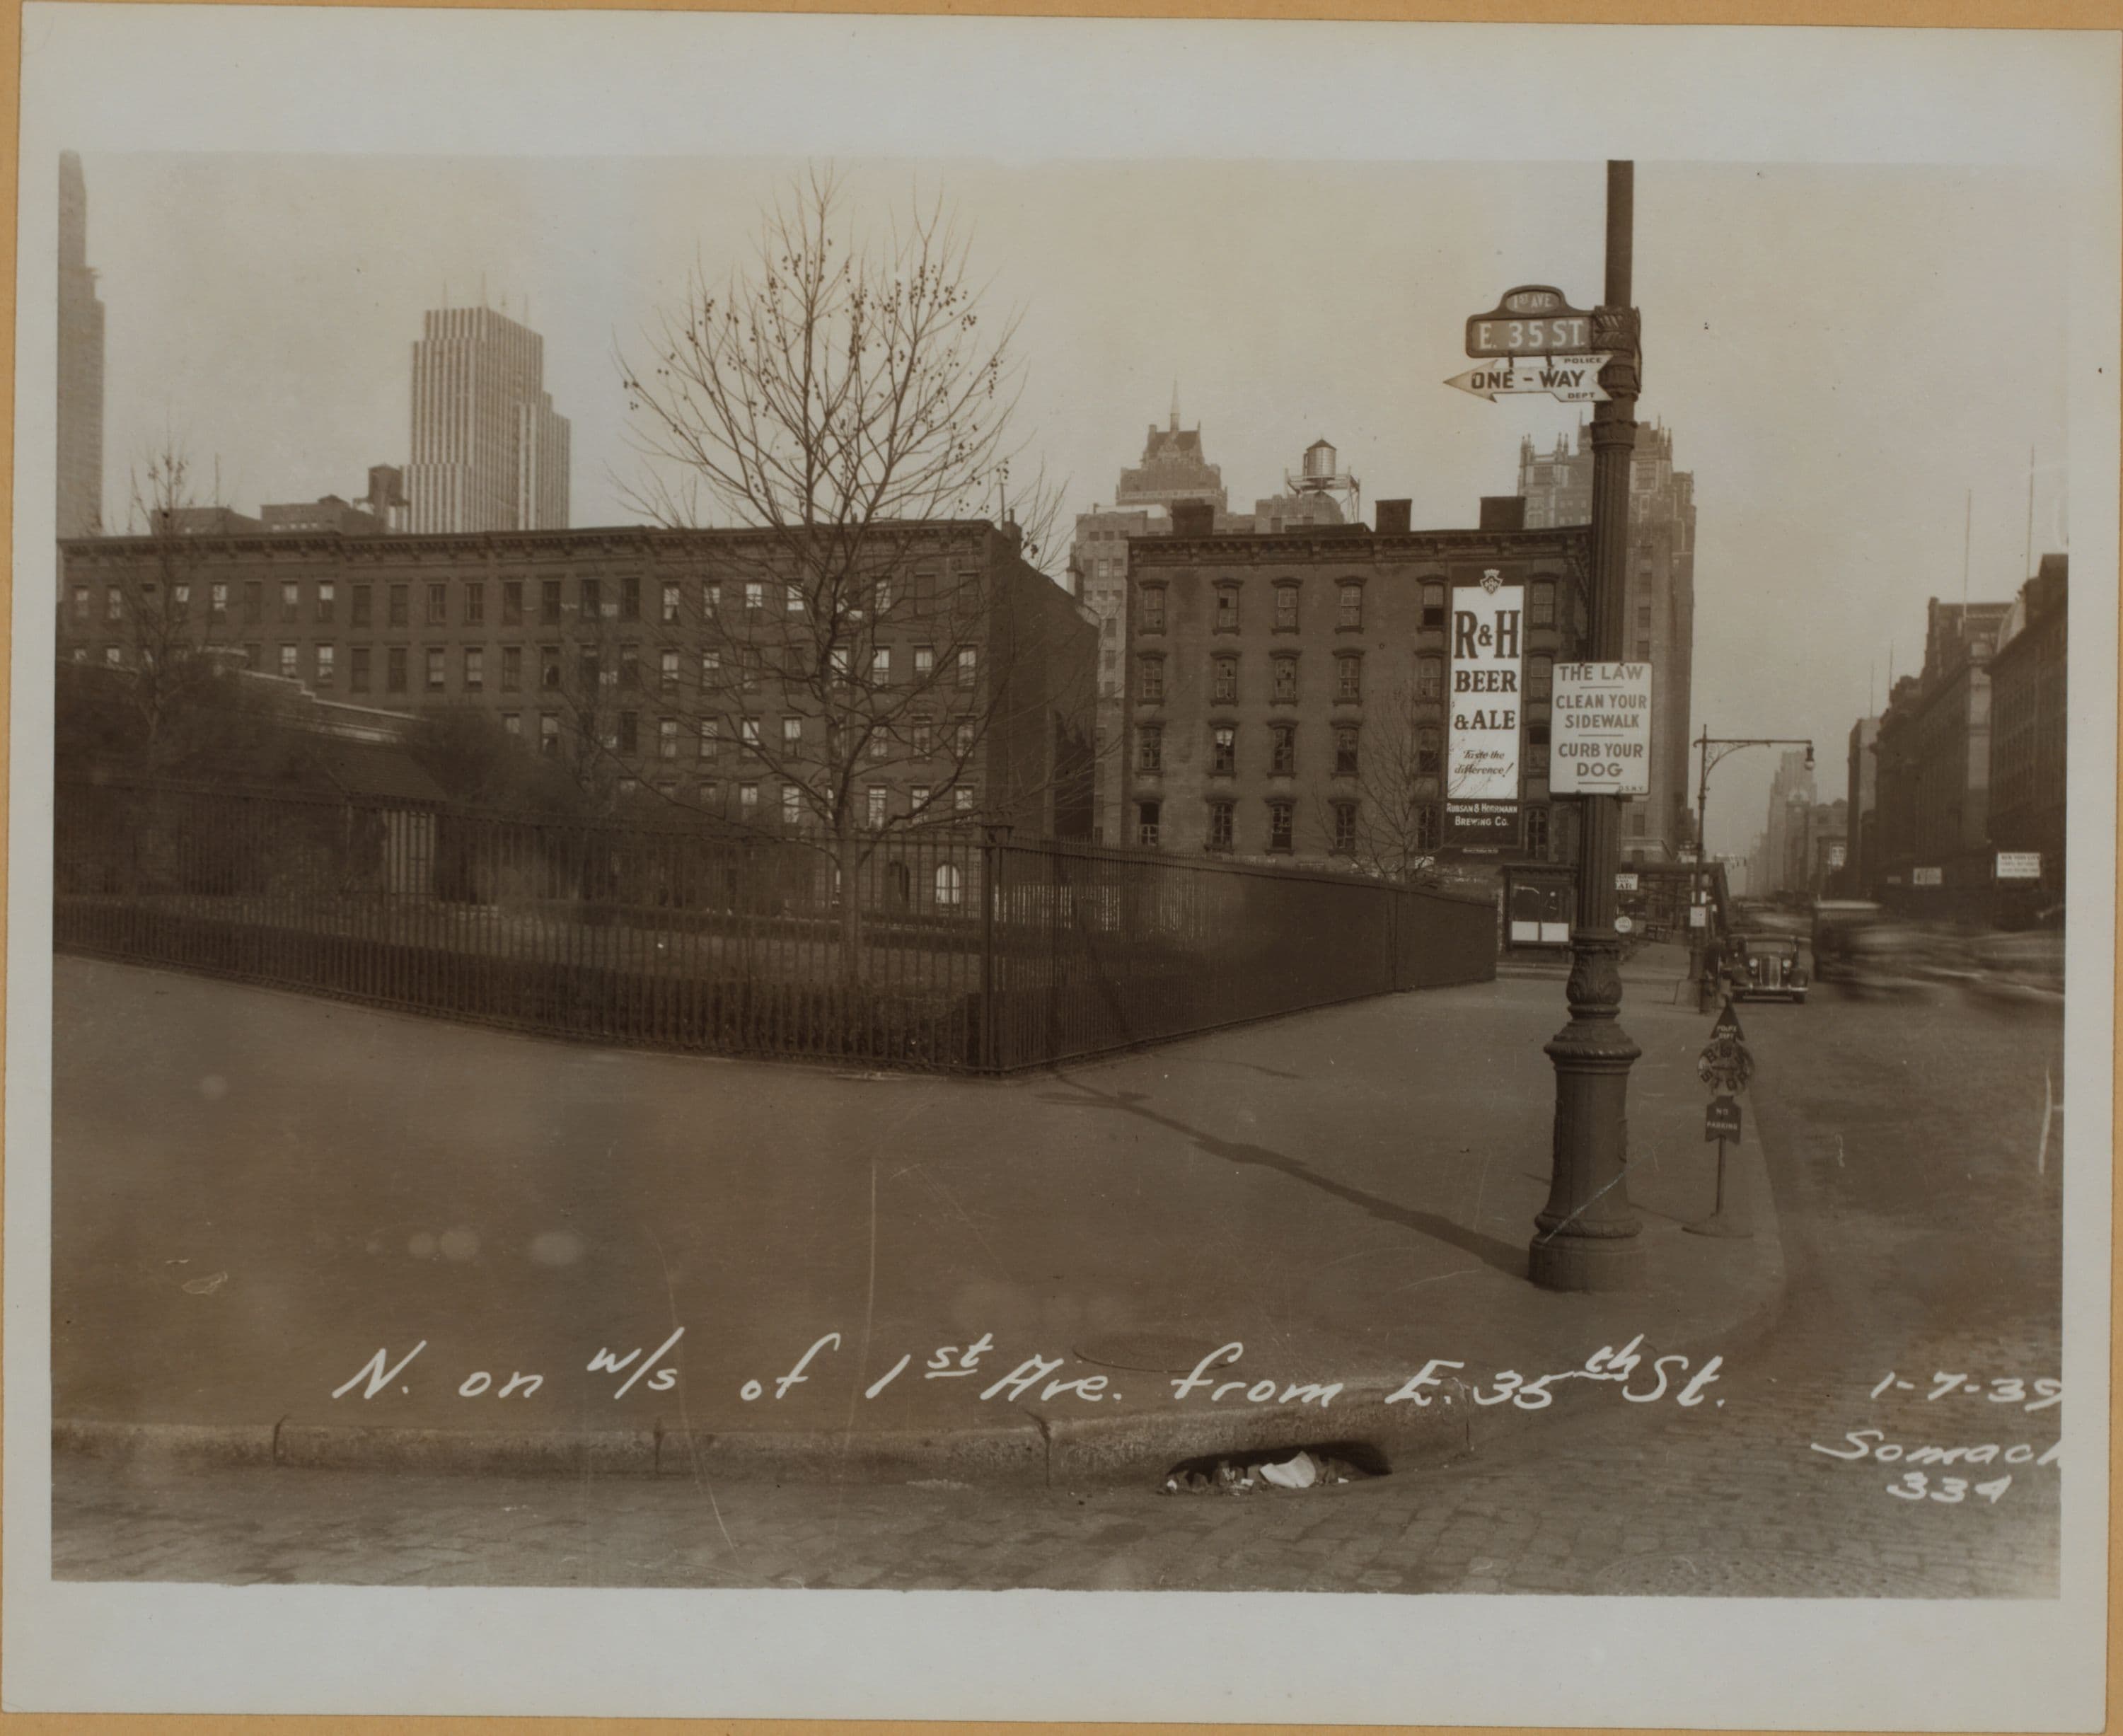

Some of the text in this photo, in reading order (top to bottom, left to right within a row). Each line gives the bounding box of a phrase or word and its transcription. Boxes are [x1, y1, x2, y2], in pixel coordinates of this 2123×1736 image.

[1531, 293, 1554, 308] AVE
[1479, 320, 1585, 349] E. 35 ST.
[1454, 610, 1521, 659] R&H
[1559, 665, 1643, 681] THE LAW
[1454, 670, 1517, 693] BEER
[1556, 694, 1648, 709] CLEAN YOUR
[1565, 714, 1640, 729] SIDEWALK
[1464, 750, 1505, 759] Taste the
[1558, 743, 1644, 758] CURB YOUR
[1577, 763, 1624, 777] DOG
[1716, 1107, 1729, 1116] NO
[1706, 1121, 1738, 1130] PARKING
